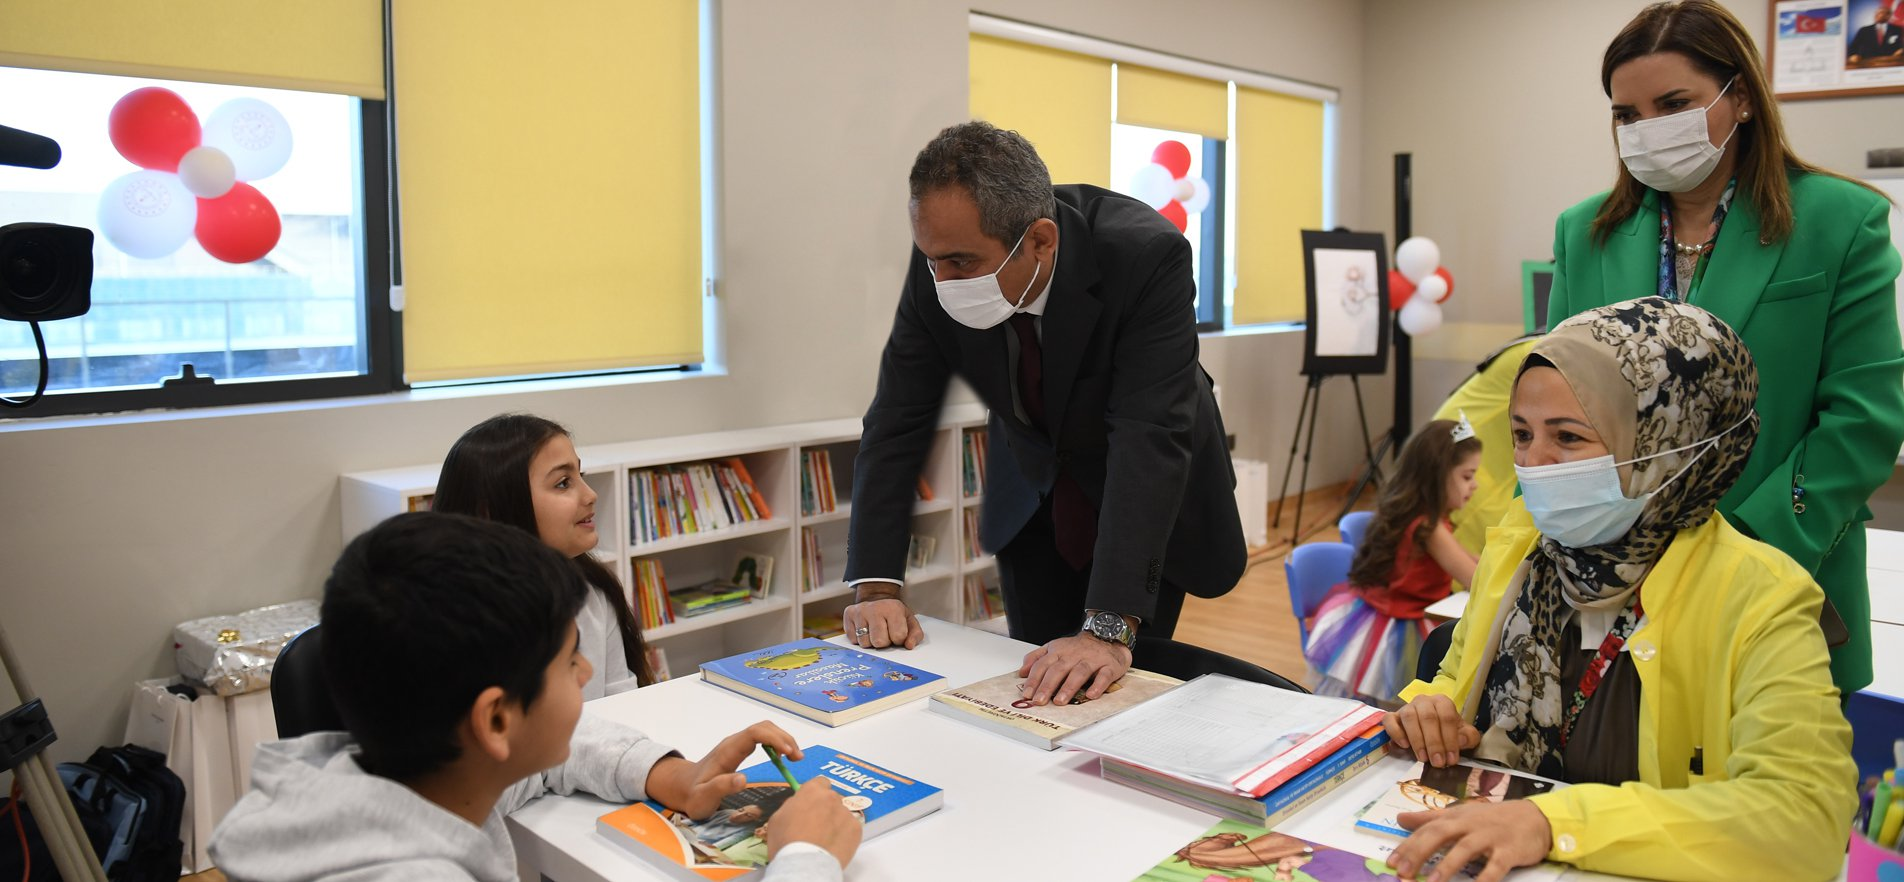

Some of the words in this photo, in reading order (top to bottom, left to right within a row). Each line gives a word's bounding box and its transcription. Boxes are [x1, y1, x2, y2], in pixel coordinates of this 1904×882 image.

[997, 708, 1012, 716] VE
[1031, 718, 1061, 730] TÜRK
[819, 760, 896, 794] TÜRKÇE
